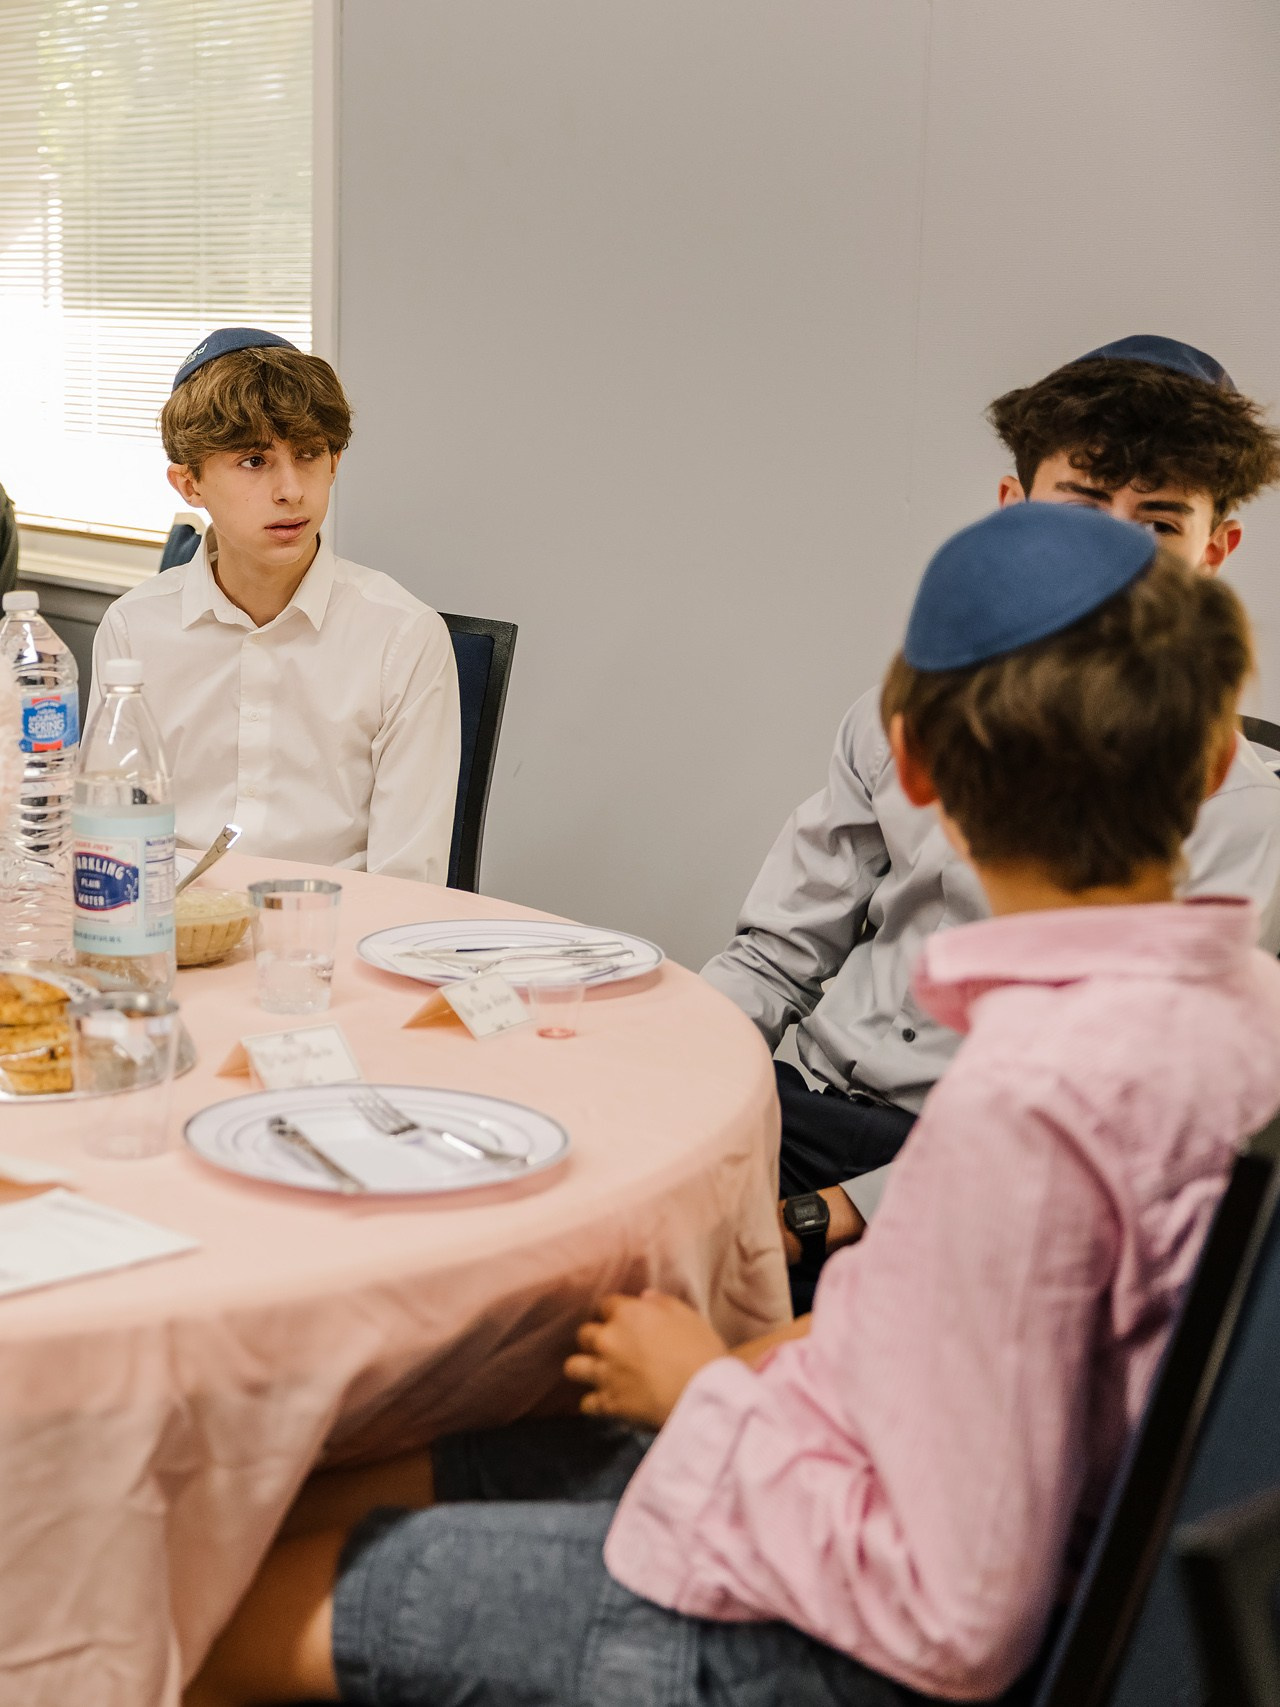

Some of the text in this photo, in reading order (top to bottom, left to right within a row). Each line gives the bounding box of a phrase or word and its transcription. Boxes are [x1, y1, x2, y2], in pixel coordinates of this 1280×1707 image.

[28, 719, 65, 733] SPRING
[80, 877, 100, 889] PLAIN
[78, 892, 104, 906] WATER
